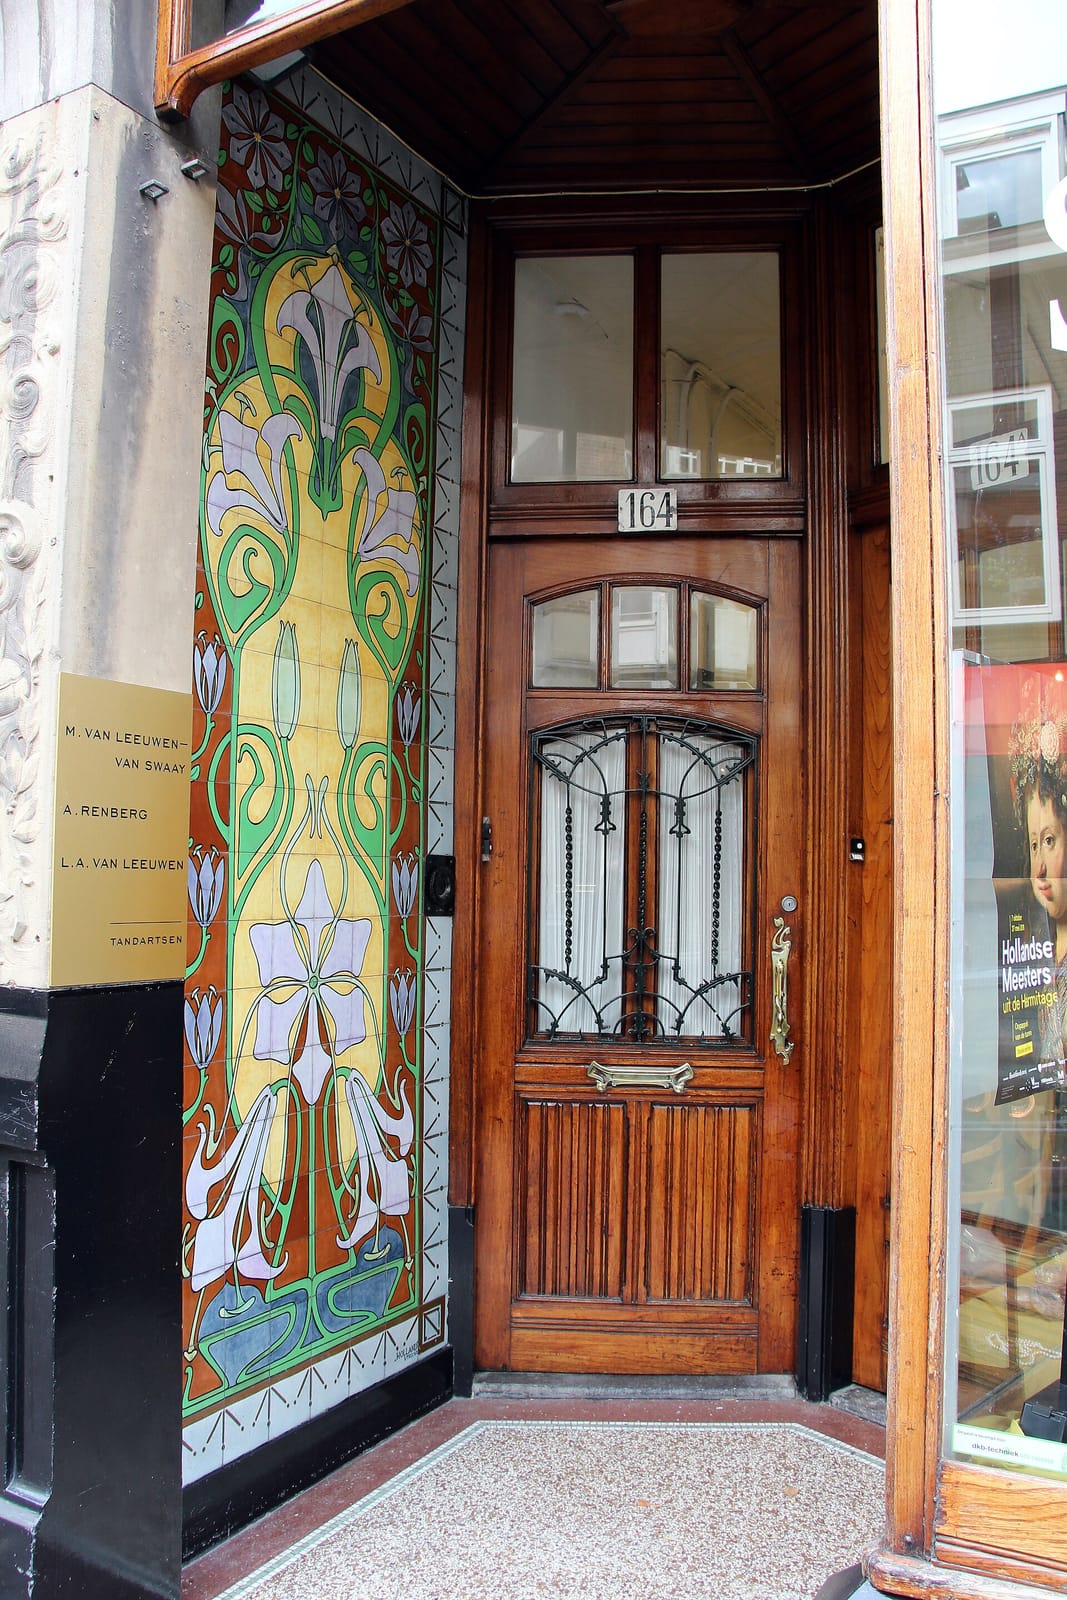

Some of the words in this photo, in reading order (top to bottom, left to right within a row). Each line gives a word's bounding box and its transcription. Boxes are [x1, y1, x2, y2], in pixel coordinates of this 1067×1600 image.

[625, 492, 673, 528] 164
[85, 728, 110, 740] VAN
[115, 757, 139, 769] VAN
[145, 760, 186, 774] SWAAY
[81, 805, 148, 820] RENBERG
[61, 857, 89, 868] L.A.
[92, 858, 118, 868] VAN
[123, 859, 184, 870] LEEUWEN
[110, 935, 183, 946] TANDARTSEN
[1002, 936, 1054, 965] Hollandse
[1002, 965, 1052, 993] Meesters
